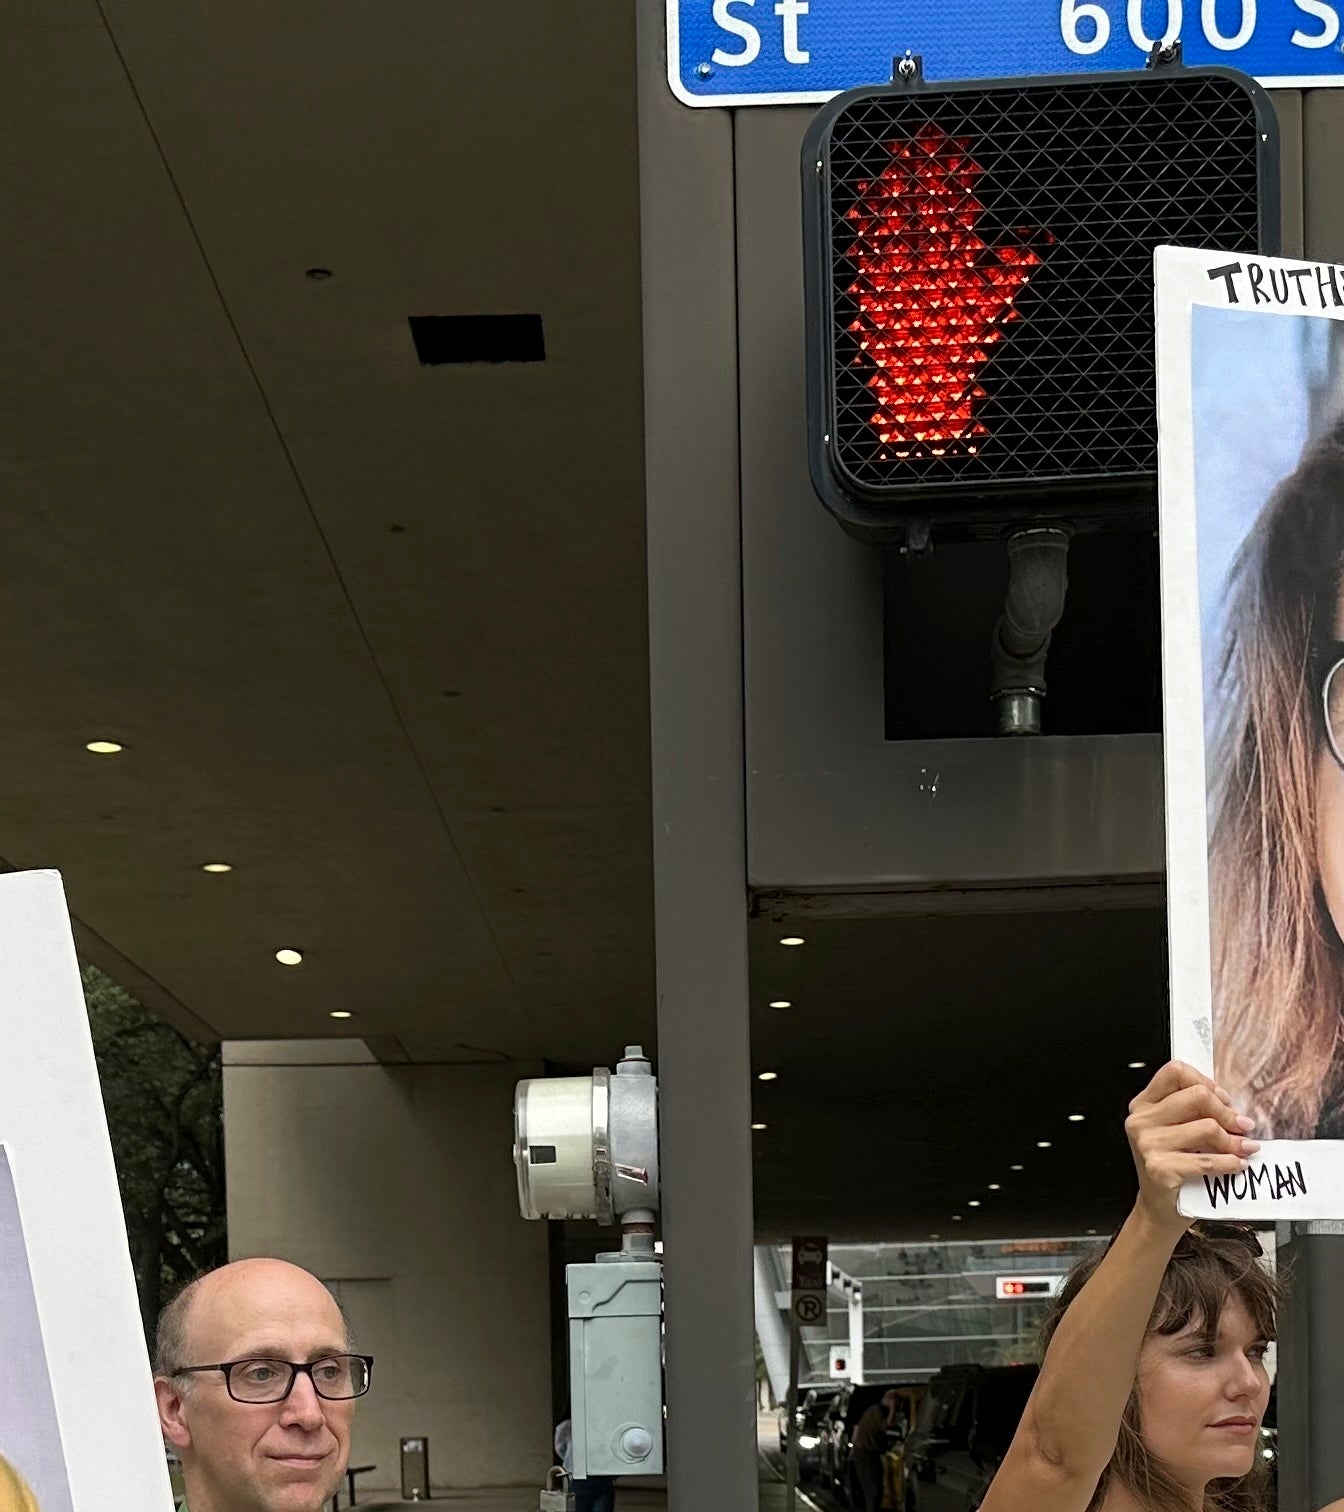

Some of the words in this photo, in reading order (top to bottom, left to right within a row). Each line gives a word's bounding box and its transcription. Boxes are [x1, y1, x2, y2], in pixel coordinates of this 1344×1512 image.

[711, 0, 810, 67] St
[1060, 0, 1257, 55] 600
[1291, 0, 1340, 49] S
[1202, 1161, 1307, 1209] WOMAN
